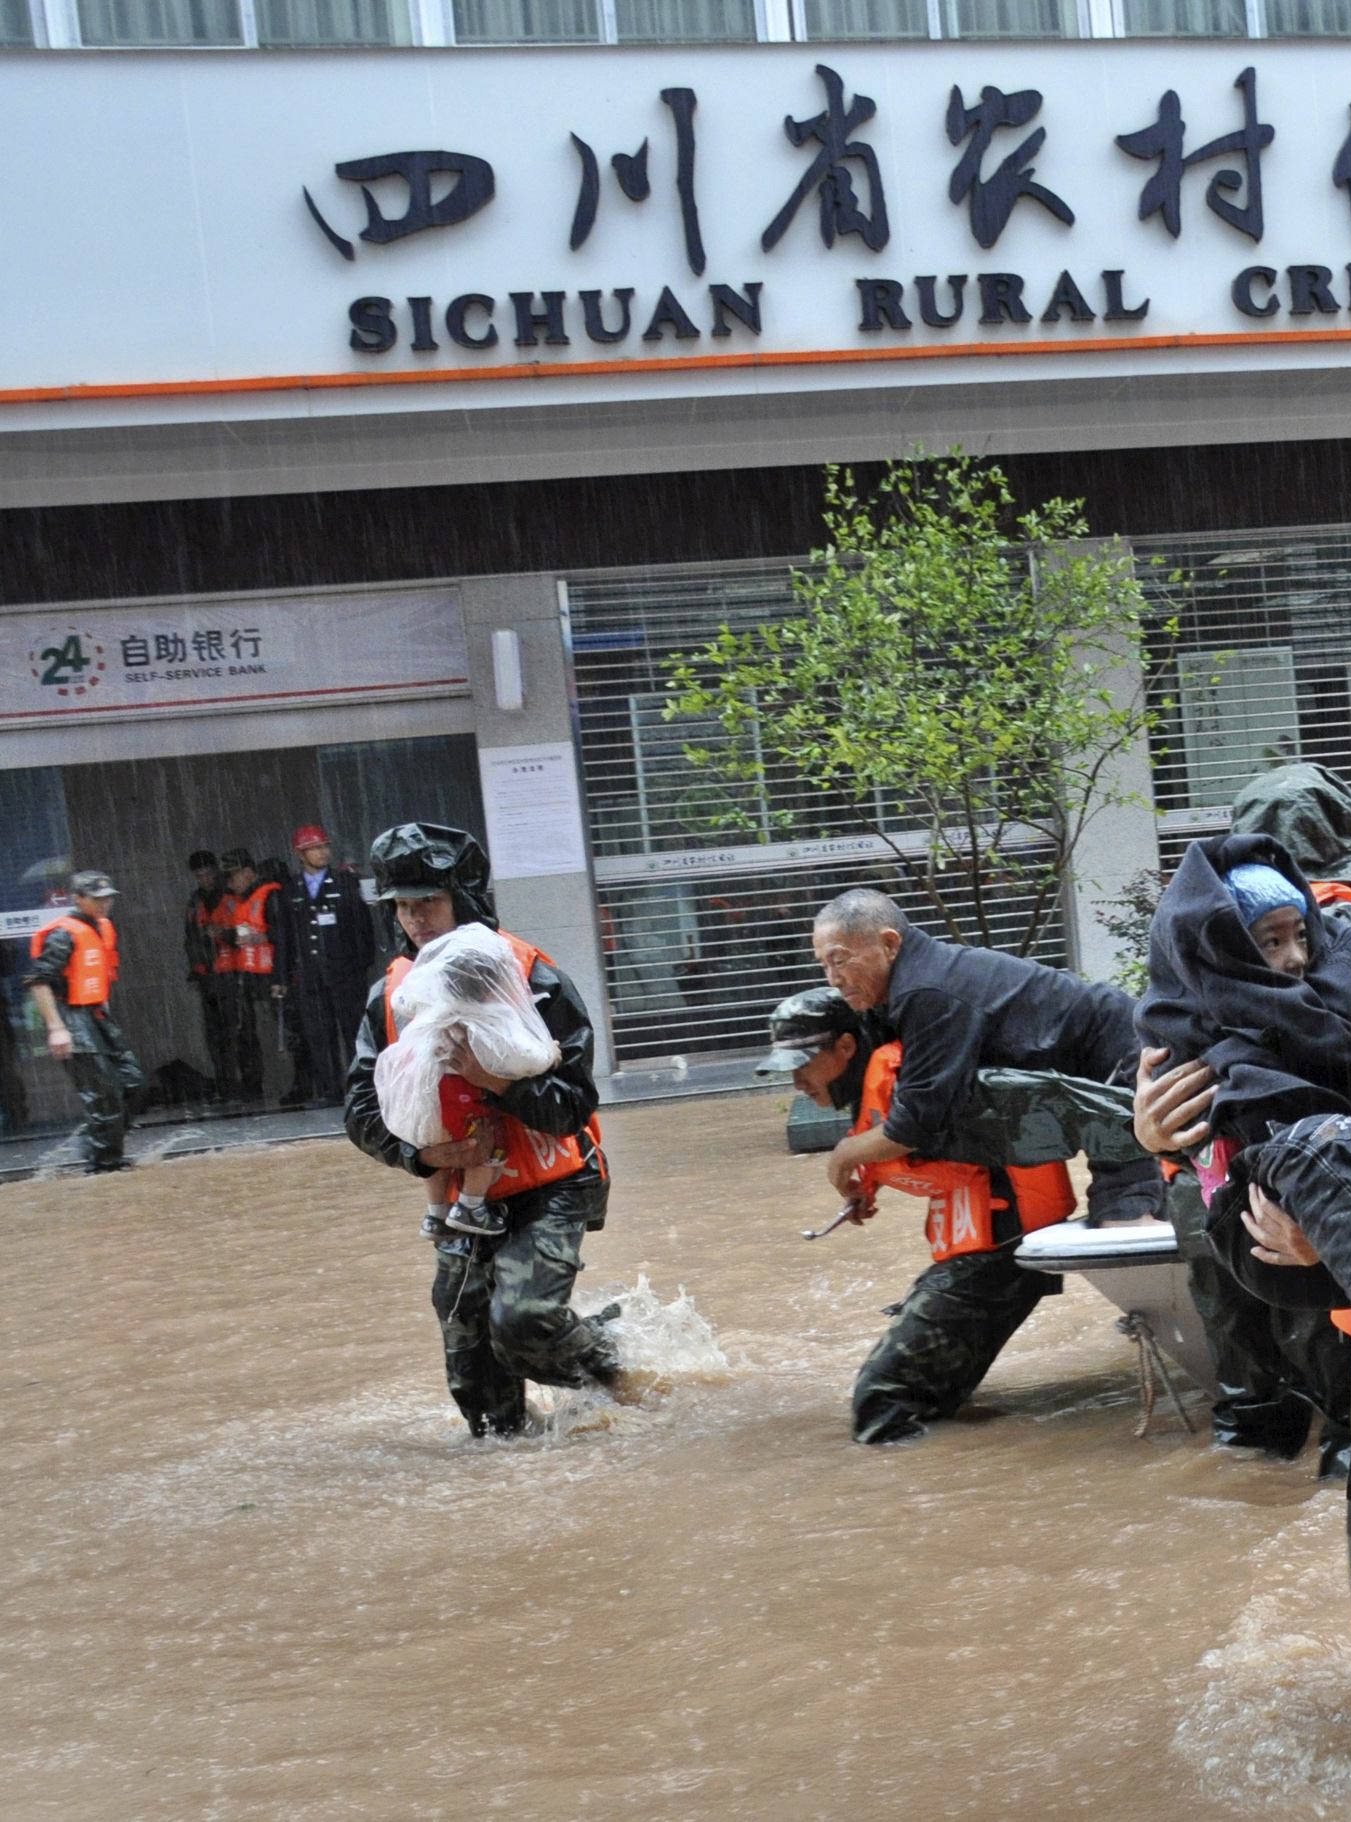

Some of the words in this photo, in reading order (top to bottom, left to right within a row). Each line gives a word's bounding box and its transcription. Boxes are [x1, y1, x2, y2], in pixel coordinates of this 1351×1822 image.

[349, 281, 764, 353] SICHUAN
[856, 269, 1150, 331] RURAL
[40, 635, 91, 686] 24
[120, 628, 262, 668] 自助银行
[124, 669, 223, 684] SELF-SERVICE
[228, 664, 268, 677] BANK
